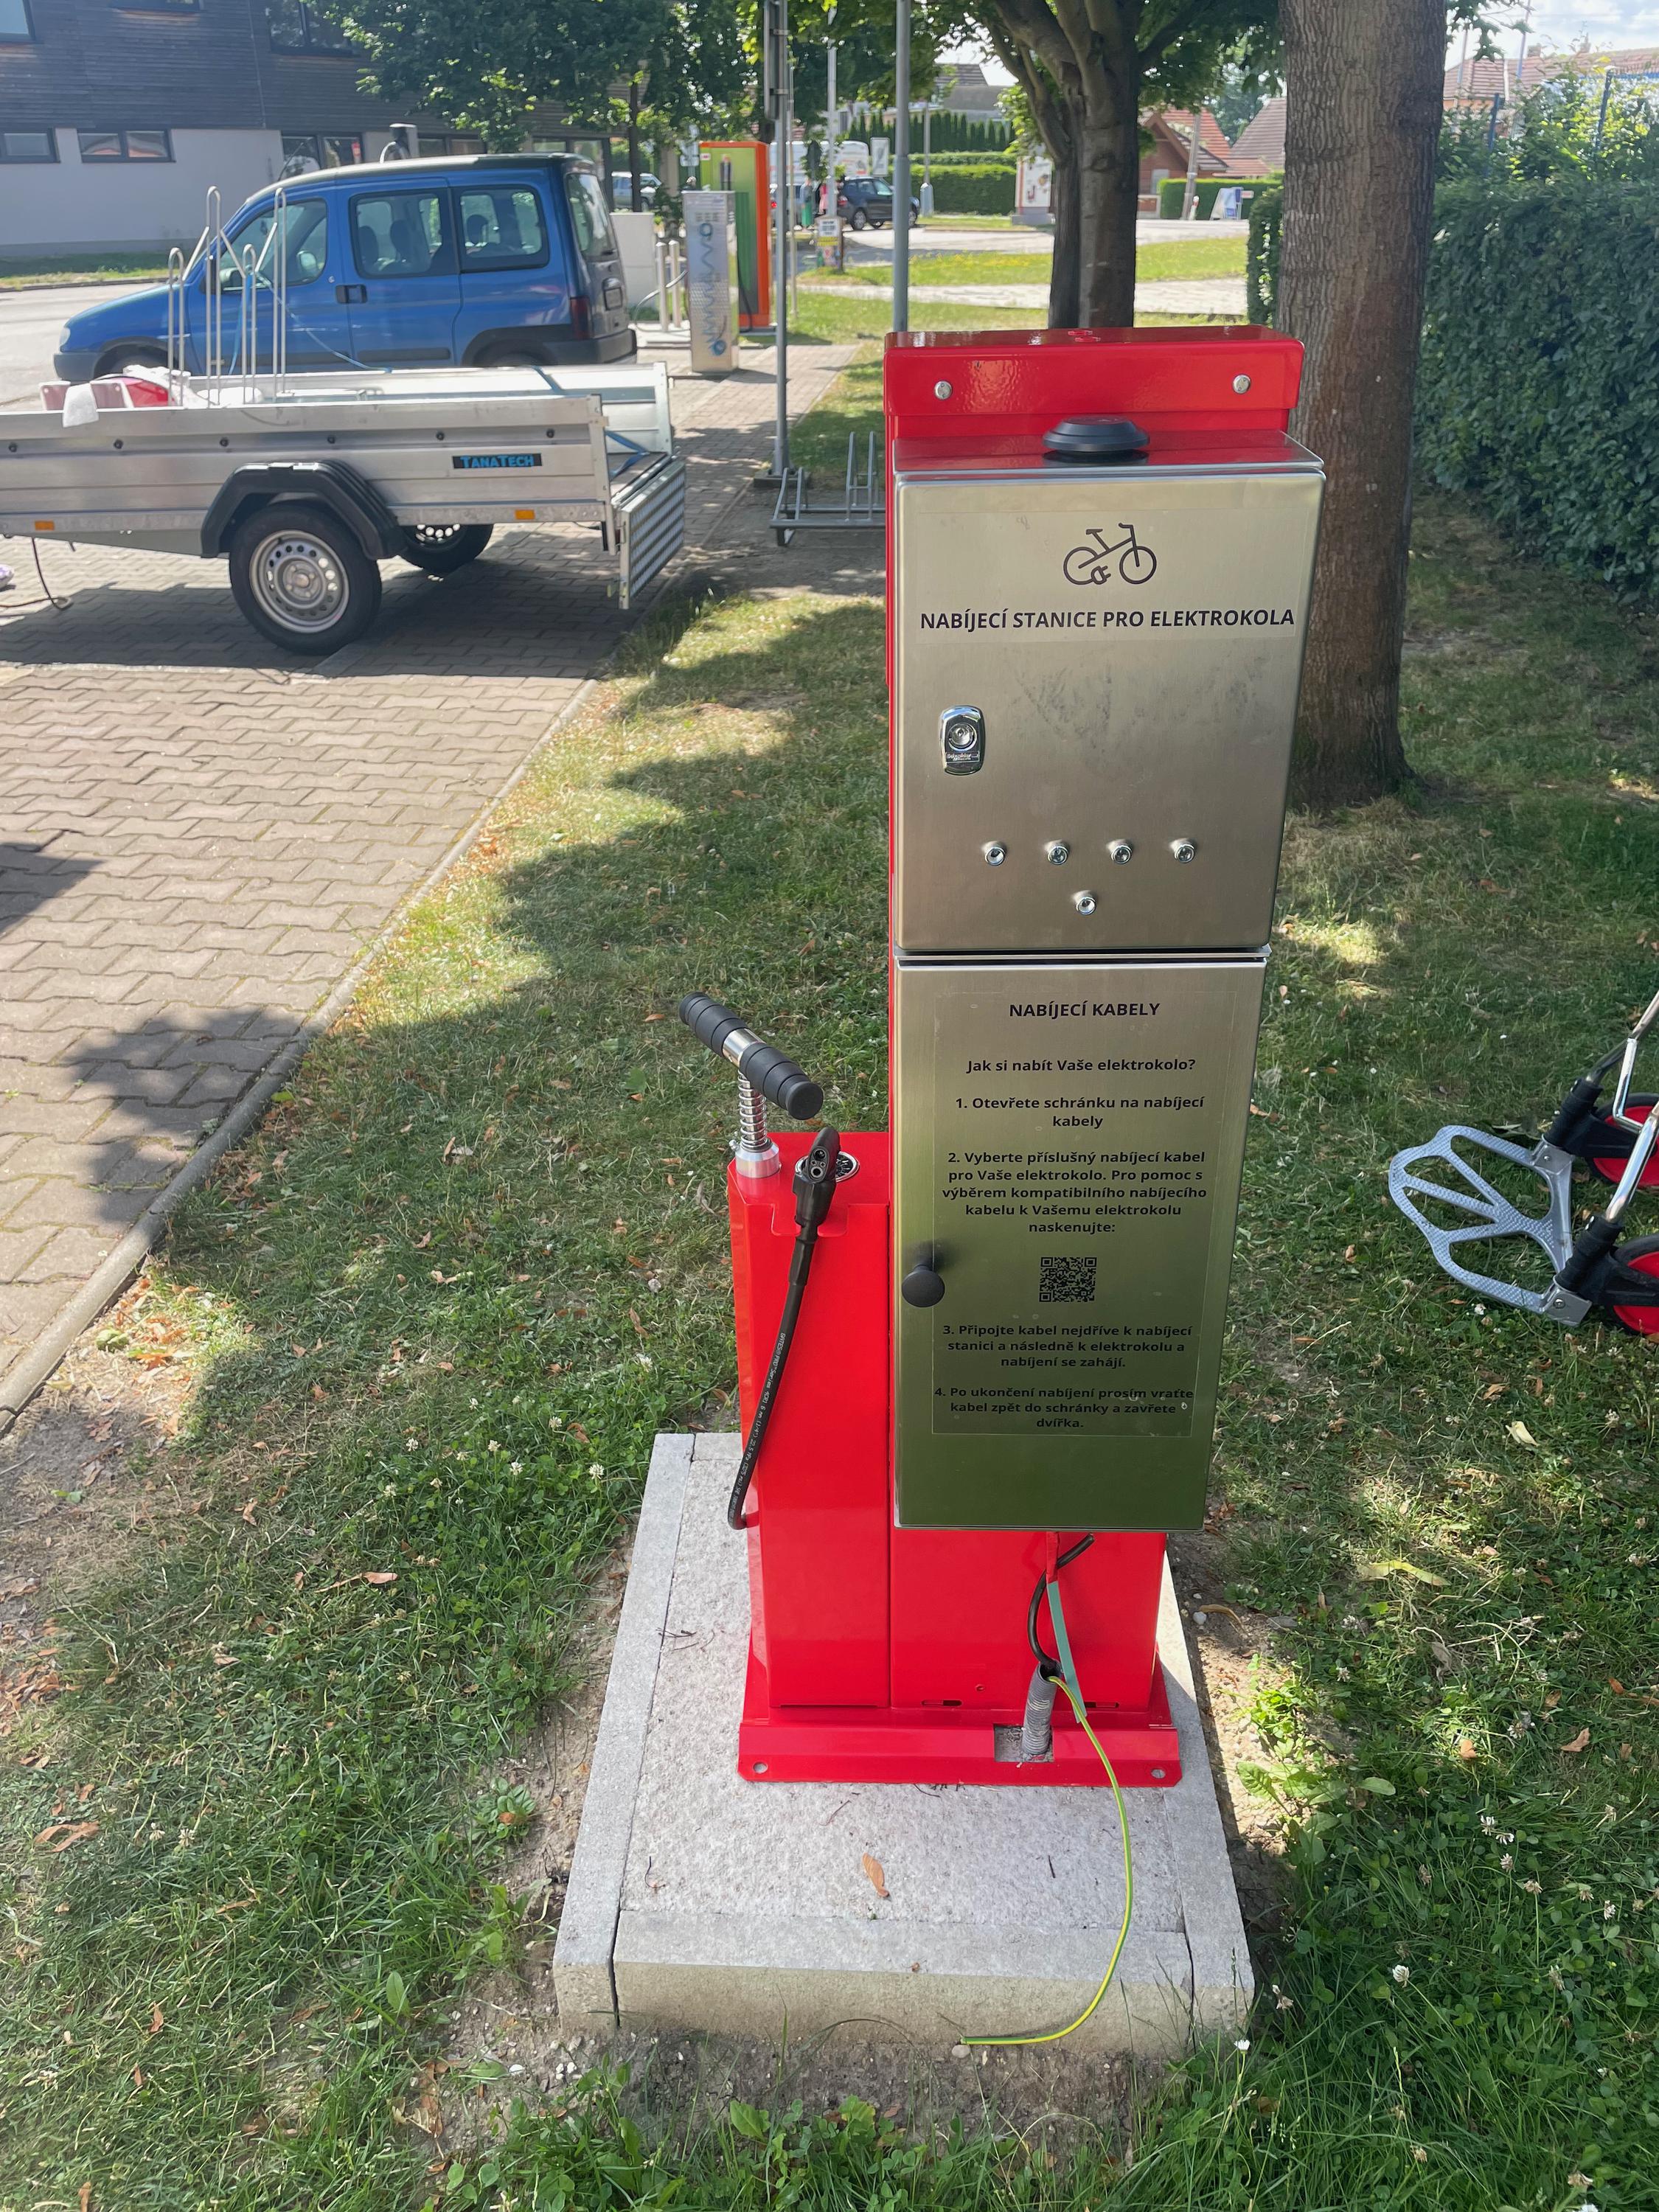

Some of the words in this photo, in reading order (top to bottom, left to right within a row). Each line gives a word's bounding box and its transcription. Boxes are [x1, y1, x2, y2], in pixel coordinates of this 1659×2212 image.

[921, 608, 1009, 633] NABÍJECÍ
[1012, 611, 1097, 628] STANICE
[1103, 611, 1144, 627] PRO
[1150, 609, 1295, 627] ELEKTROKOLA
[1009, 1000, 1088, 1020] NABÍJECÍ
[1092, 1003, 1161, 1016] KABELY
[965, 1060, 992, 1074] Jak
[995, 1060, 1007, 1071] si
[1012, 1059, 1053, 1071] nabít
[1057, 1059, 1093, 1071] Vaše
[1097, 1058, 1196, 1071] elektrokolo?
[956, 1098, 967, 1109] 1.
[972, 1096, 1040, 1109] Otevřete
[1043, 1096, 1116, 1109] schránku
[1120, 1099, 1139, 1108] na
[1144, 1096, 1205, 1111] nabíjecí
[1052, 1115, 1104, 1130] kabely
[947, 1152, 961, 1163] 2.
[964, 1152, 1023, 1166] Vyberte
[1027, 1151, 1096, 1166] příslušný
[1100, 1151, 1161, 1166] nabíjecí
[1164, 1151, 1205, 1163] kabel
[948, 1172, 973, 1183] pro
[977, 1169, 1012, 1180] Vaše
[1016, 1169, 1107, 1180] elektrokolo.
[1111, 1169, 1136, 1180] Pro
[1141, 1172, 1192, 1183] pomoc
[1194, 1172, 1203, 1180] s
[942, 1186, 1006, 1201] výběrem
[1011, 1186, 1125, 1201] kompatibilního
[1130, 1186, 1207, 1201] nabíjecího
[965, 1204, 1015, 1215] kabelu
[1019, 1204, 1029, 1215] k
[1032, 1204, 1091, 1216] Vašemu
[1095, 1204, 1181, 1215] elektrokolu
[1029, 1222, 1116, 1235] naskenujte:
[942, 1325, 955, 1335] 3.
[959, 1324, 1015, 1338] Připojte
[1018, 1325, 1057, 1335] kabel
[1061, 1325, 1119, 1338] nejdříve
[1123, 1326, 1132, 1336] k
[1136, 1326, 1193, 1339] nabíjecí
[947, 1340, 994, 1351] stanici
[998, 1343, 1006, 1351] a
[1010, 1340, 1074, 1352] následně
[1078, 1341, 1087, 1352] k
[1090, 1341, 1172, 1352] elektrokolu
[1001, 1356, 1059, 1369] nabíjení
[1061, 1359, 1077, 1367] se
[1079, 1357, 1126, 1370] zahájí.
[934, 1387, 947, 1397] 4.
[950, 1387, 967, 1397] Po
[970, 1387, 1035, 1397] ukončení
[1038, 1388, 1095, 1400] nabíjení
[1098, 1388, 1147, 1401] prosím
[1150, 1388, 1193, 1399] vraťte
[950, 1402, 987, 1412] kabel
[991, 1402, 1021, 1415] zpět
[1024, 1402, 1042, 1413] do
[1045, 1403, 1109, 1416] schránky
[1112, 1405, 1121, 1413] a
[1124, 1403, 1176, 1413] zavřete
[1036, 1418, 1084, 1427] dvířka.
